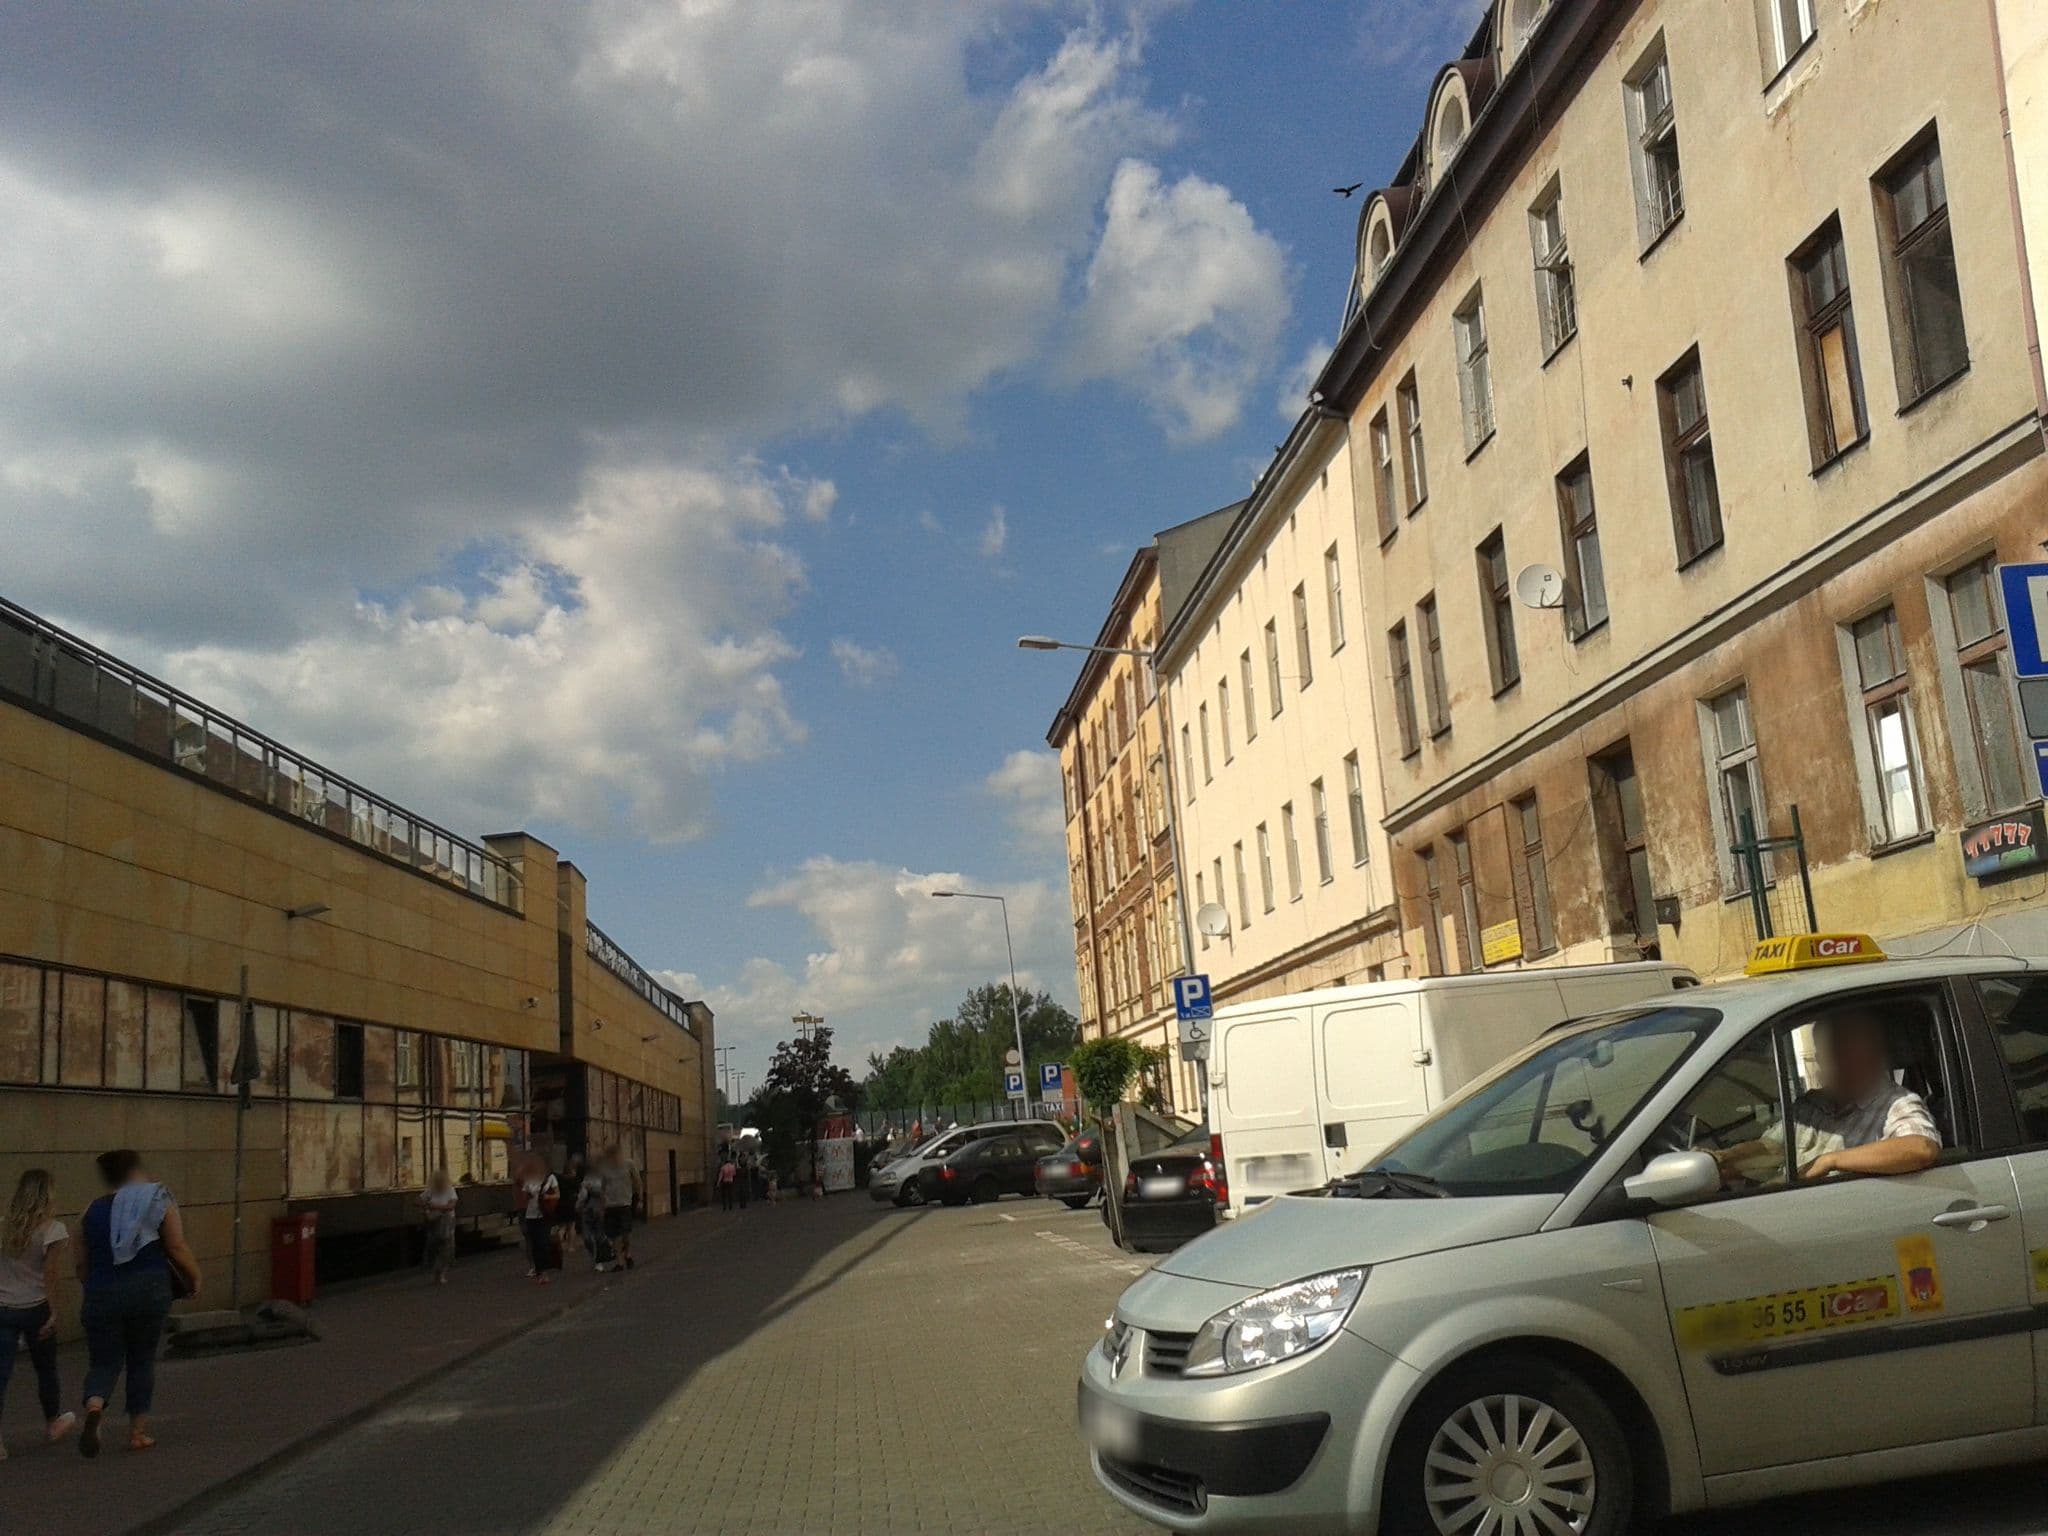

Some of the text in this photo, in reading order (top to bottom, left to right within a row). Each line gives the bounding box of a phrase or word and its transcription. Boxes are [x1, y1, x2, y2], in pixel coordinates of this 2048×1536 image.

[1754, 939, 1859, 960] TAXI iCar
[1181, 979, 1204, 1009] P
[1009, 1075, 1021, 1090] P
[1045, 1065, 1058, 1083] P
[1045, 1102, 1064, 1112] TAXI
[1783, 1300, 1806, 1324] 55
